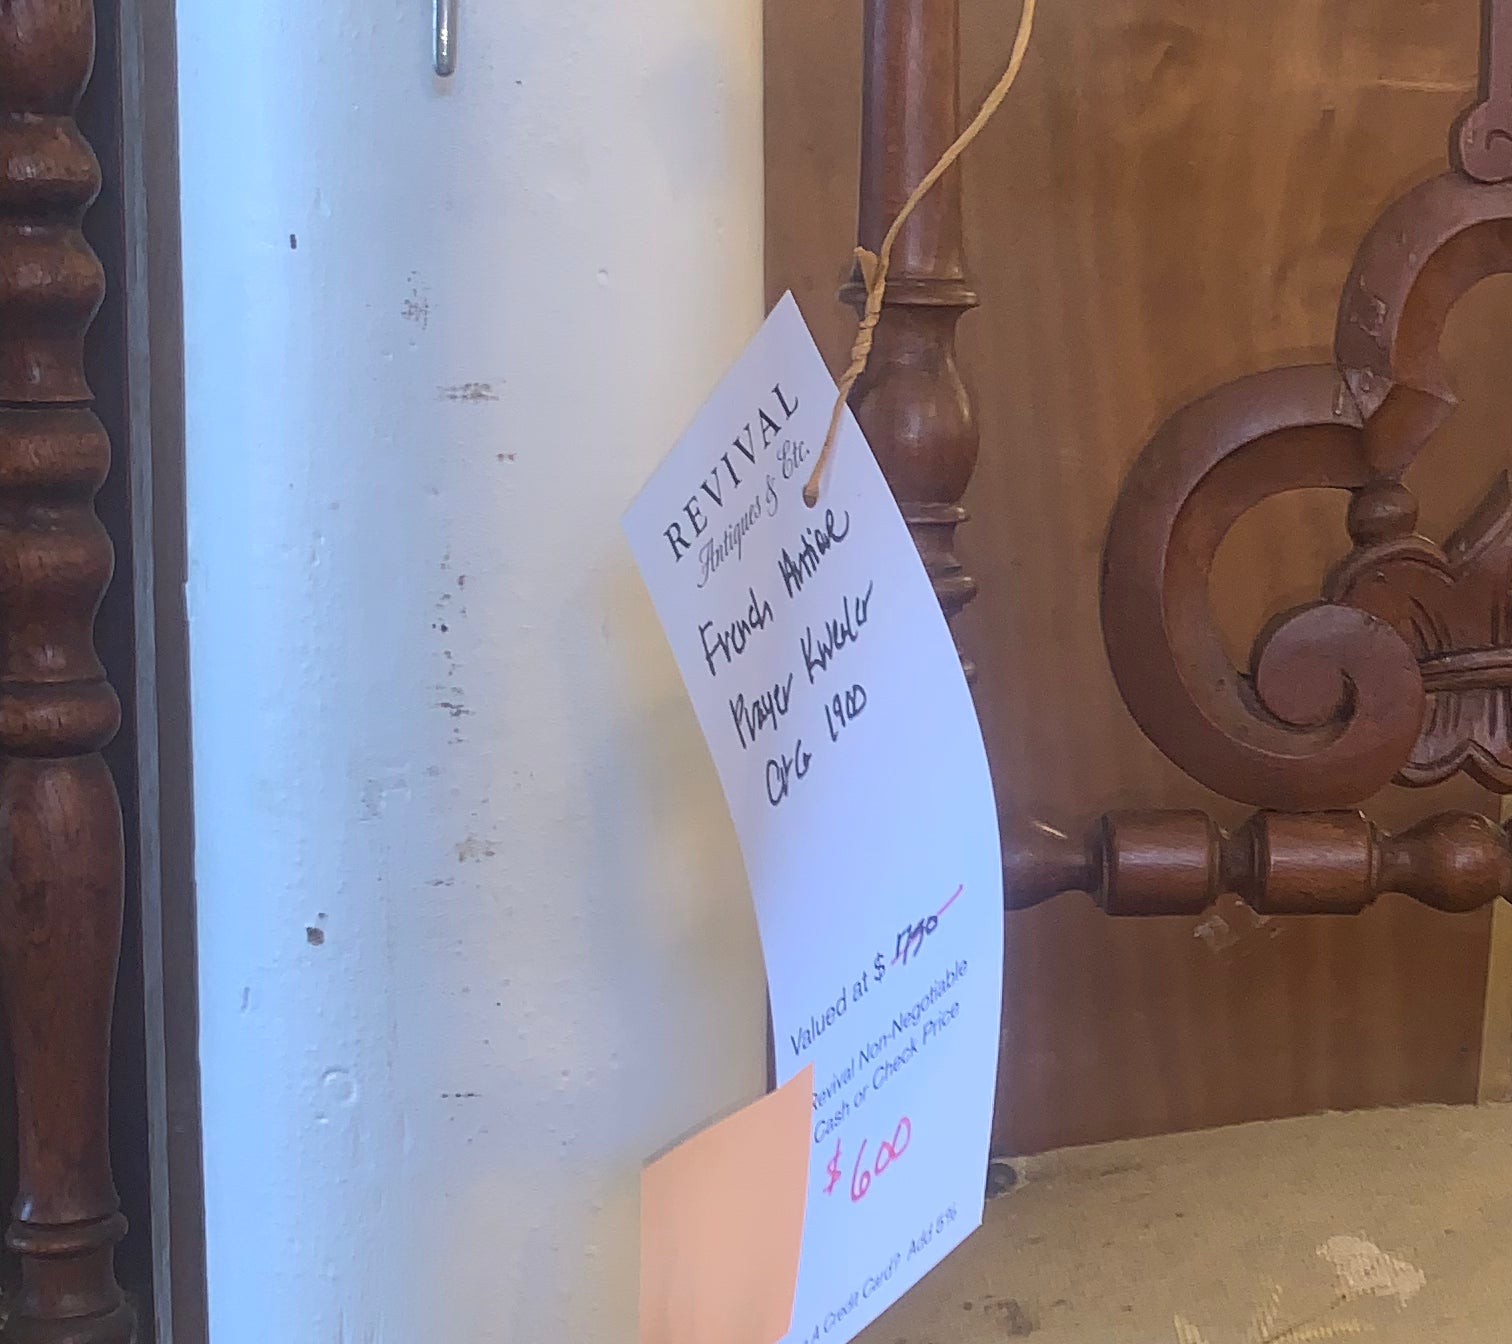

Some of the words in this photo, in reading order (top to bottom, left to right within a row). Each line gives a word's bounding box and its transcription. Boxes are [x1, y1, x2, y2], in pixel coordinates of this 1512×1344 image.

[663, 382, 799, 563] REVIVAL
[697, 495, 762, 588] Antiques
[698, 587, 774, 677] French
[729, 672, 793, 750] Prayer
[824, 684, 867, 743] 1900
[790, 986, 847, 1057] Valued
[852, 970, 869, 1002] at
[874, 952, 886, 985] $
[859, 959, 968, 1071] Non-Negotiable
[813, 1100, 850, 1144] Cash
[853, 1084, 870, 1108] or
[872, 1037, 918, 1090] Check
[922, 1002, 960, 1045] Price
[823, 1137, 842, 1195] $
[850, 1115, 912, 1203] 600
[811, 1324, 821, 1344] A
[823, 1291, 860, 1334] Credit
[907, 1223, 934, 1262] Add
